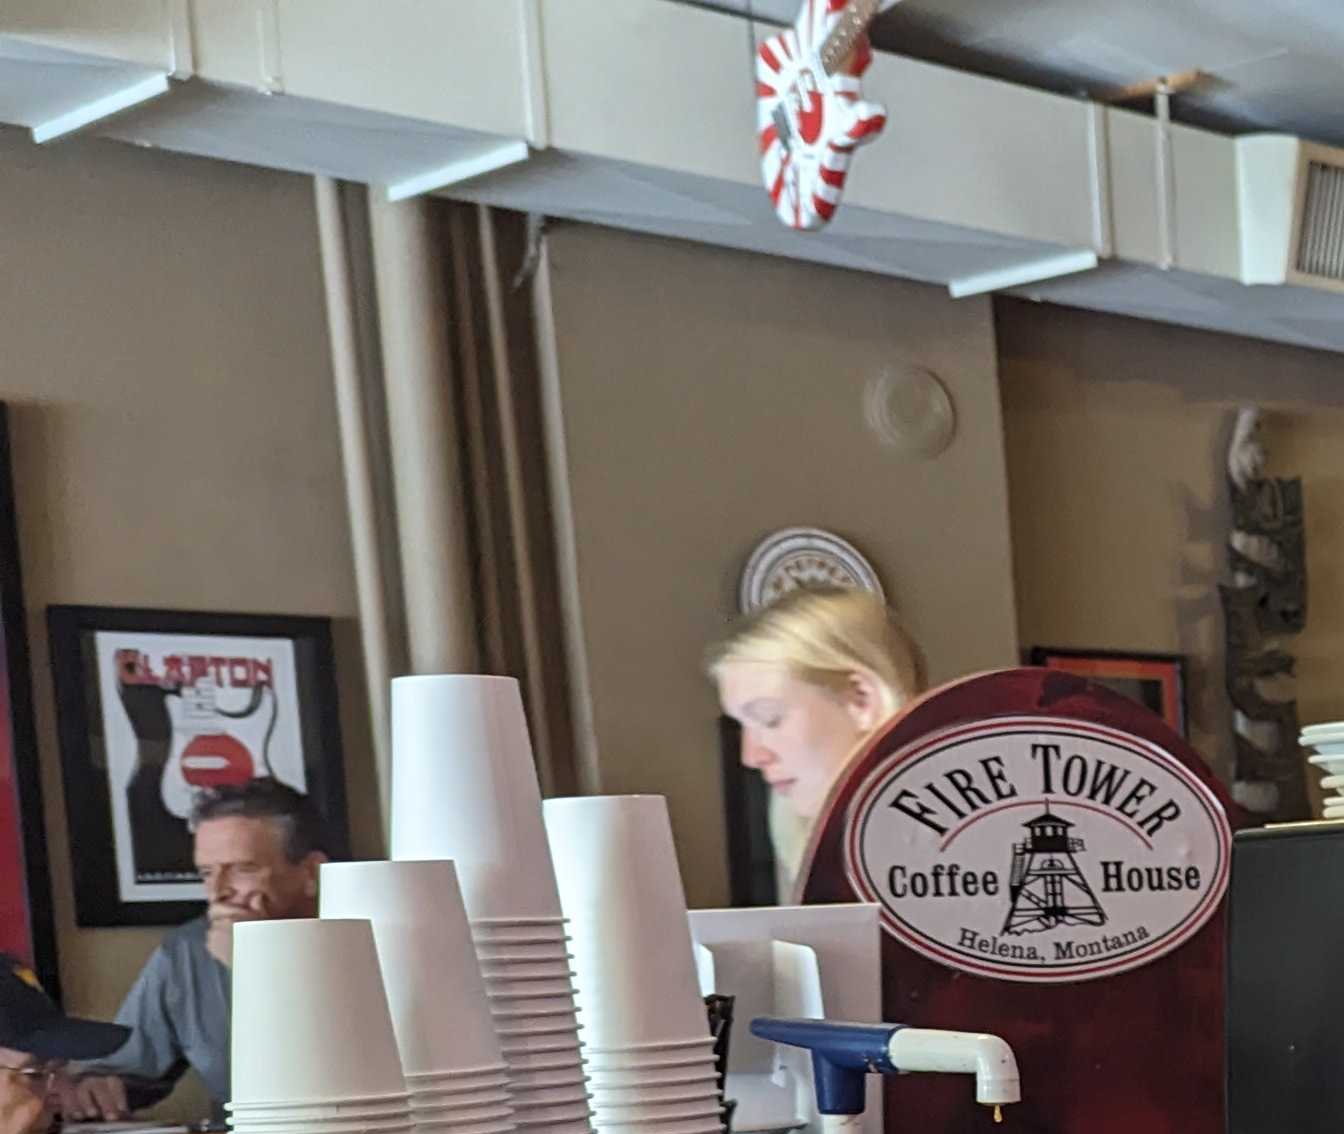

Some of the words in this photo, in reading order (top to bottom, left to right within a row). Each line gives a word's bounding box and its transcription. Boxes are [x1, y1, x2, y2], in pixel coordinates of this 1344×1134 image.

[890, 756, 1018, 836] FIRE
[1031, 744, 1182, 837] TOWER
[888, 863, 1000, 898] Coffee
[1100, 860, 1201, 894] House
[957, 927, 1046, 962] Helena,
[1054, 925, 1151, 961] Montana
